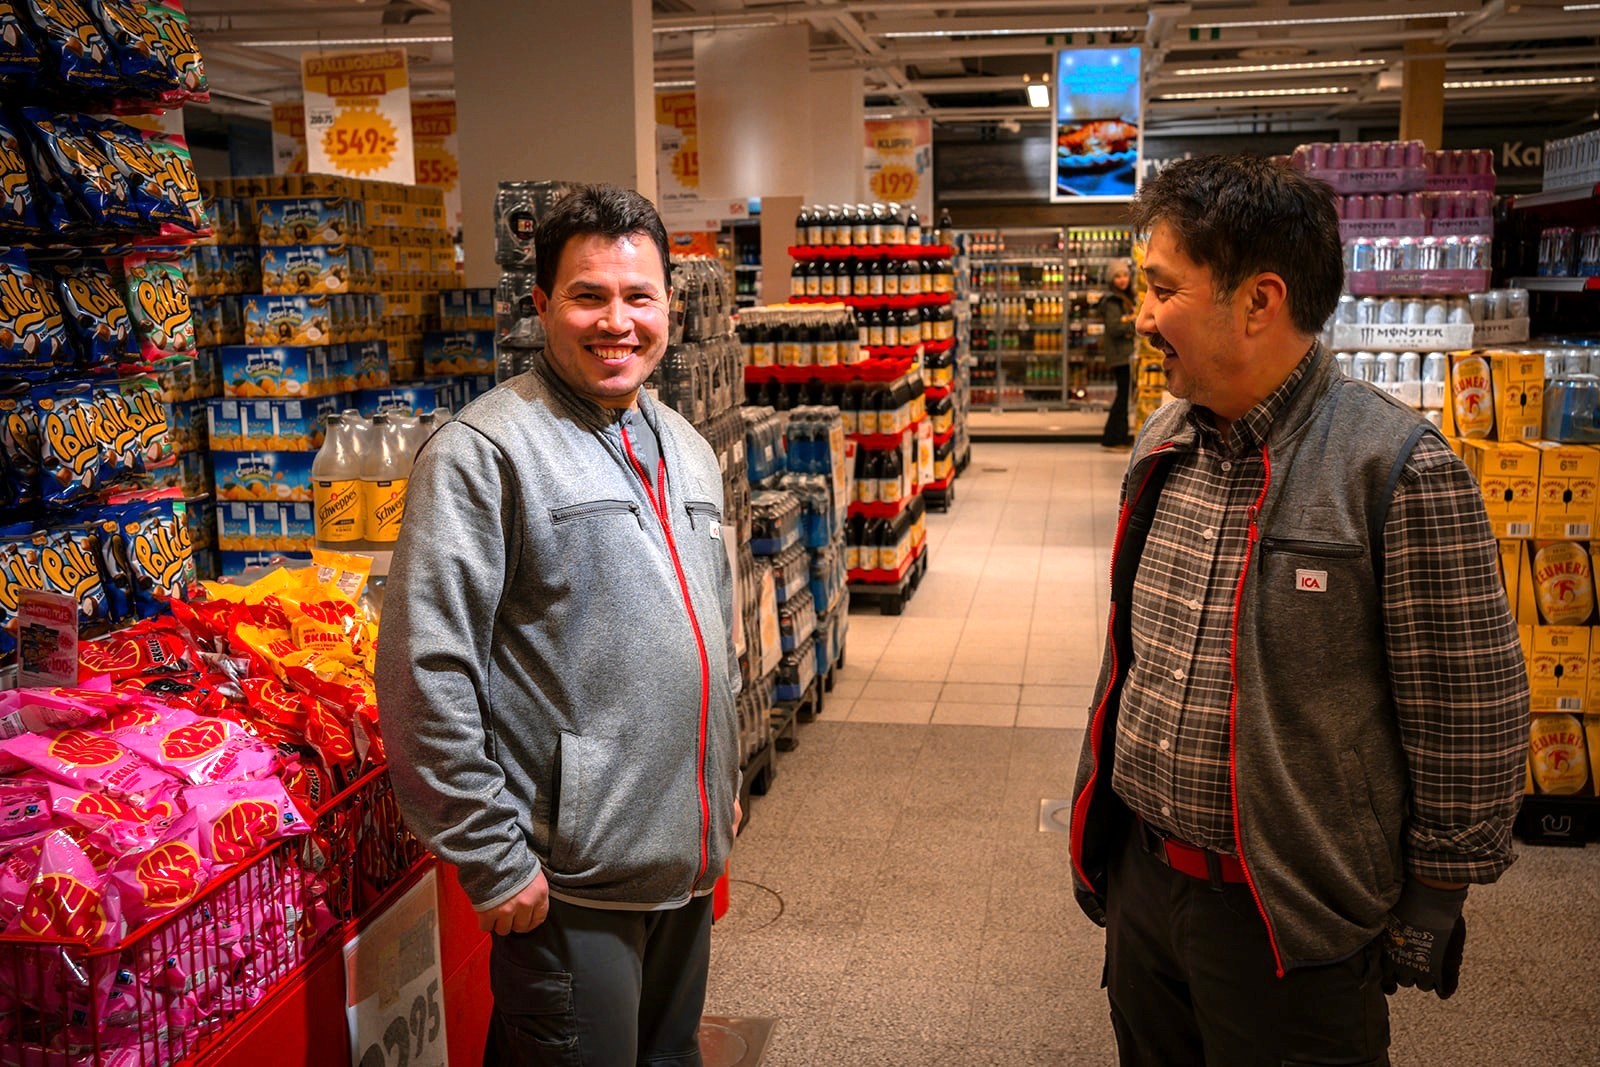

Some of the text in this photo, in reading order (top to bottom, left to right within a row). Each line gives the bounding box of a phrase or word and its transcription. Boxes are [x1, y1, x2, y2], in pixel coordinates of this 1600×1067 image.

[336, 128, 395, 155] 549:-
[137, 277, 191, 339] Polly
[1376, 327, 1444, 339] MONSTER
[319, 490, 357, 526] Schweppes
[1301, 576, 1320, 589] ICA
